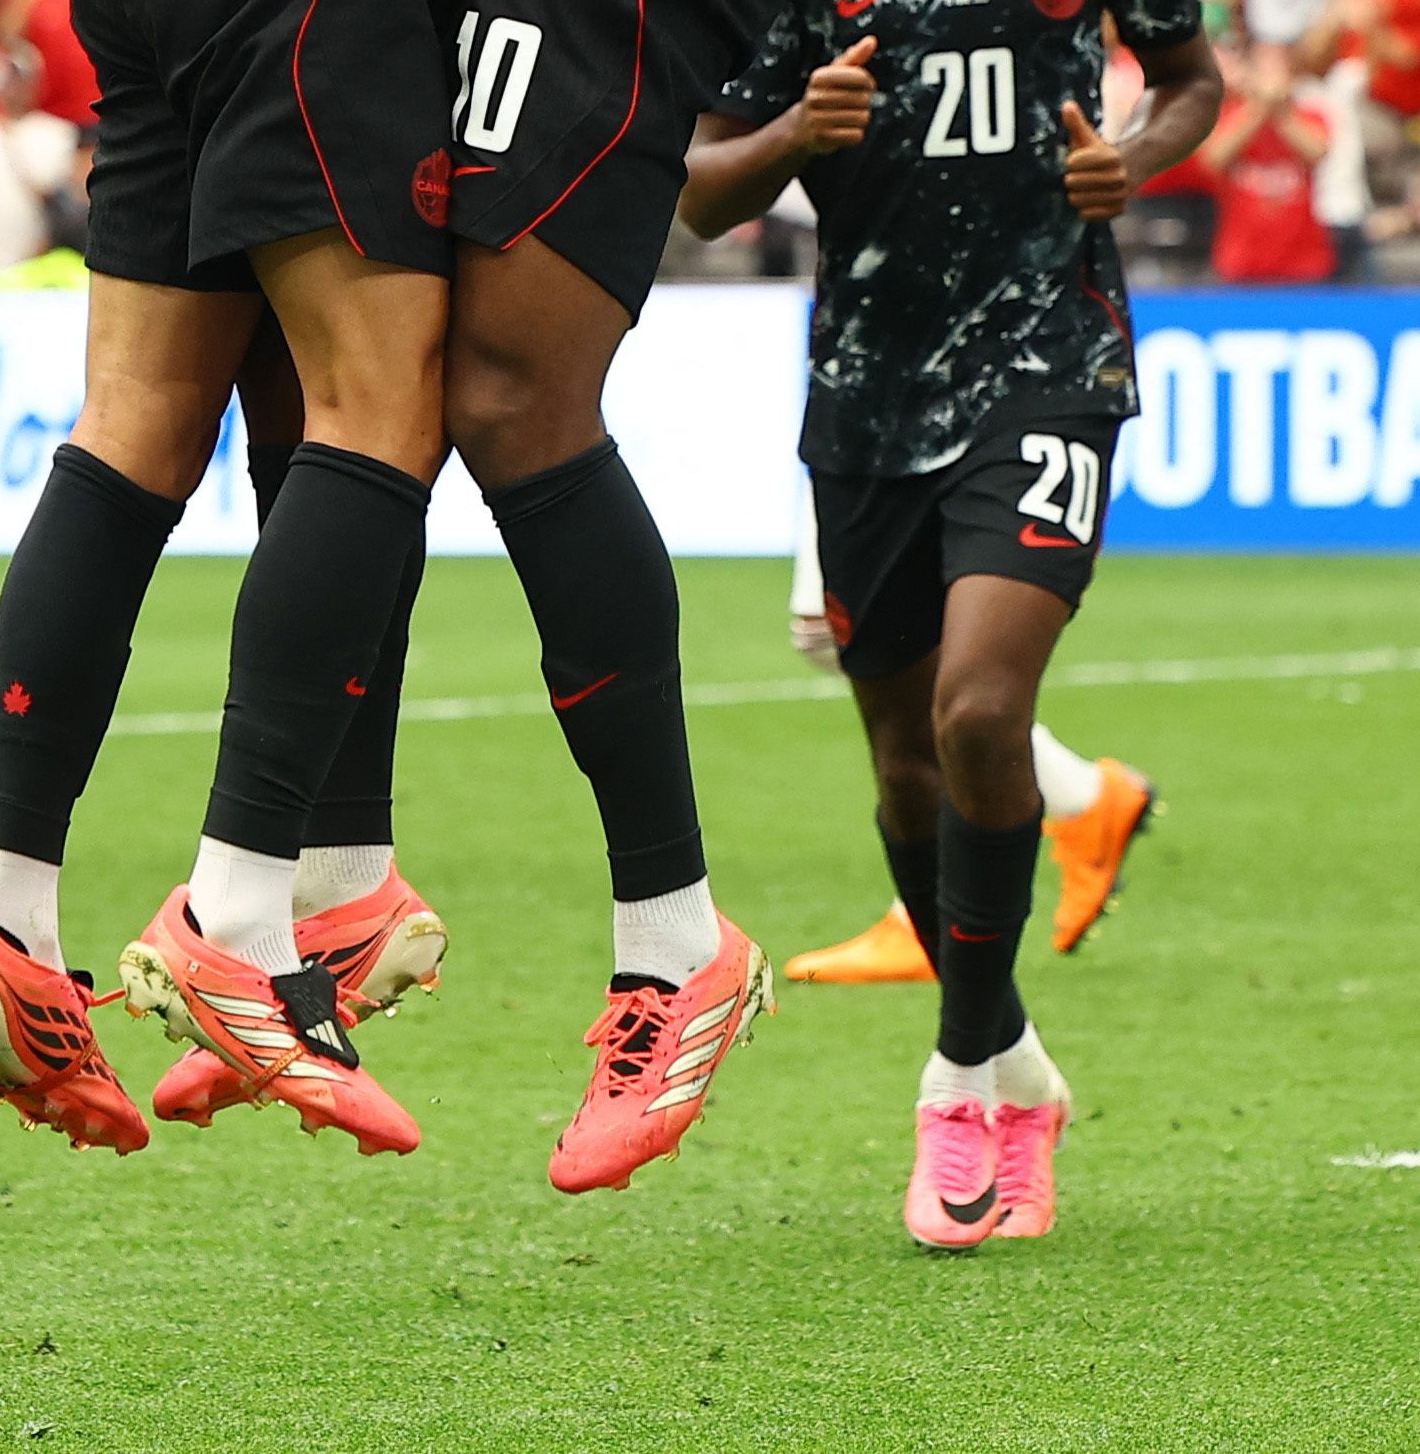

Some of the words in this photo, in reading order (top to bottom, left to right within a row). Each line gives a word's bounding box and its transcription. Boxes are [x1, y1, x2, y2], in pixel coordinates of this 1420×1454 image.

[450, 9, 543, 153] 10
[920, 47, 1016, 158] 20
[1017, 432, 1100, 545] 20
